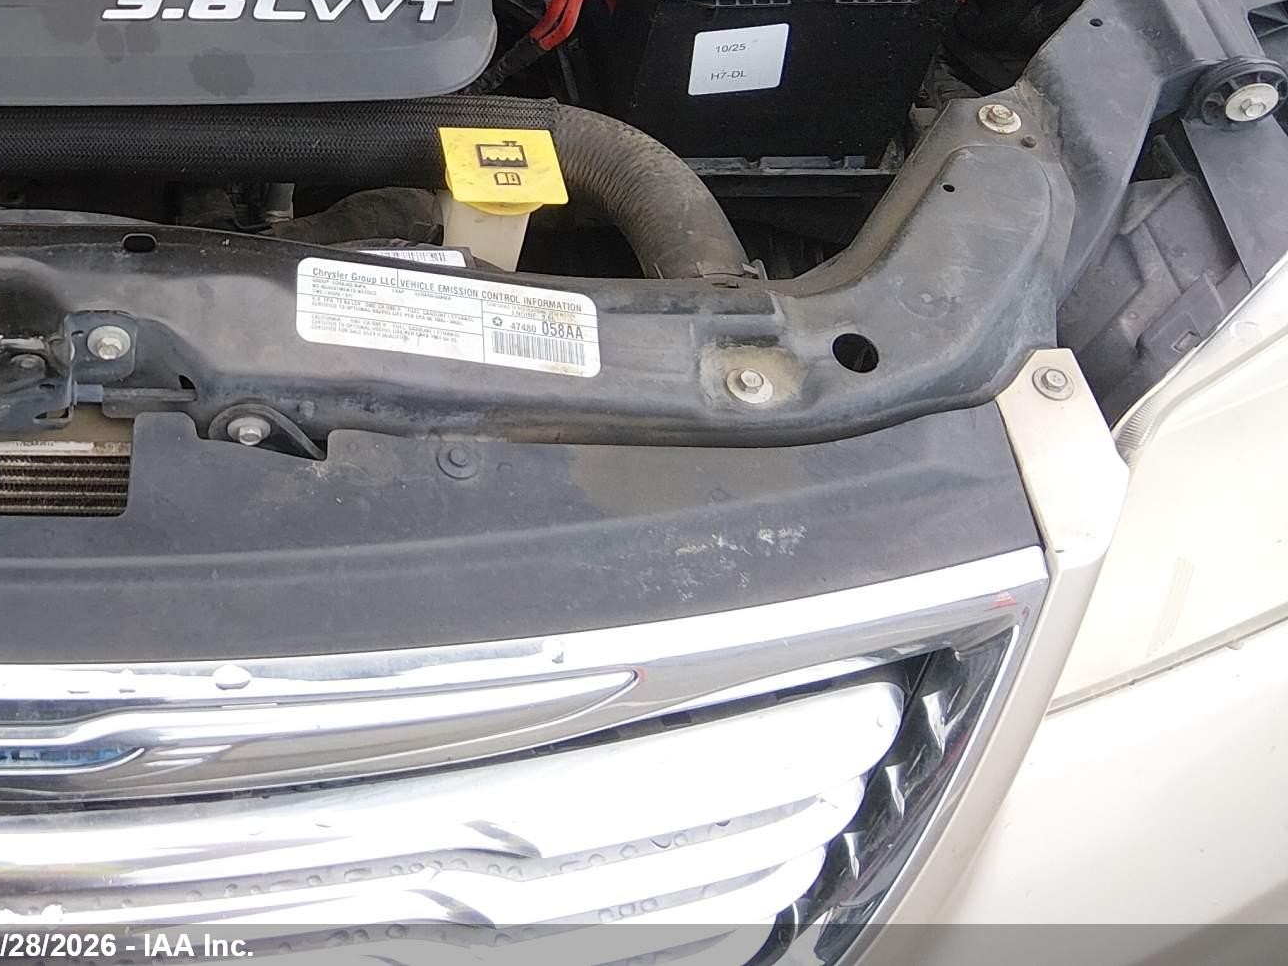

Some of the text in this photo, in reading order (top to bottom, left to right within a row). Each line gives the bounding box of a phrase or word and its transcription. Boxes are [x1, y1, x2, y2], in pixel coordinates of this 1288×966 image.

[715, 43, 746, 53] 10/25
[711, 70, 747, 81] H7-DL
[312, 268, 348, 280] Chrysler
[351, 272, 377, 284] Group
[380, 276, 396, 285] LLC
[400, 280, 434, 291] VEHICLE
[438, 285, 479, 298] EMISSION
[482, 290, 520, 304] CONTROL
[524, 297, 582, 312] INFORMATION
[542, 321, 583, 339] 058AA
